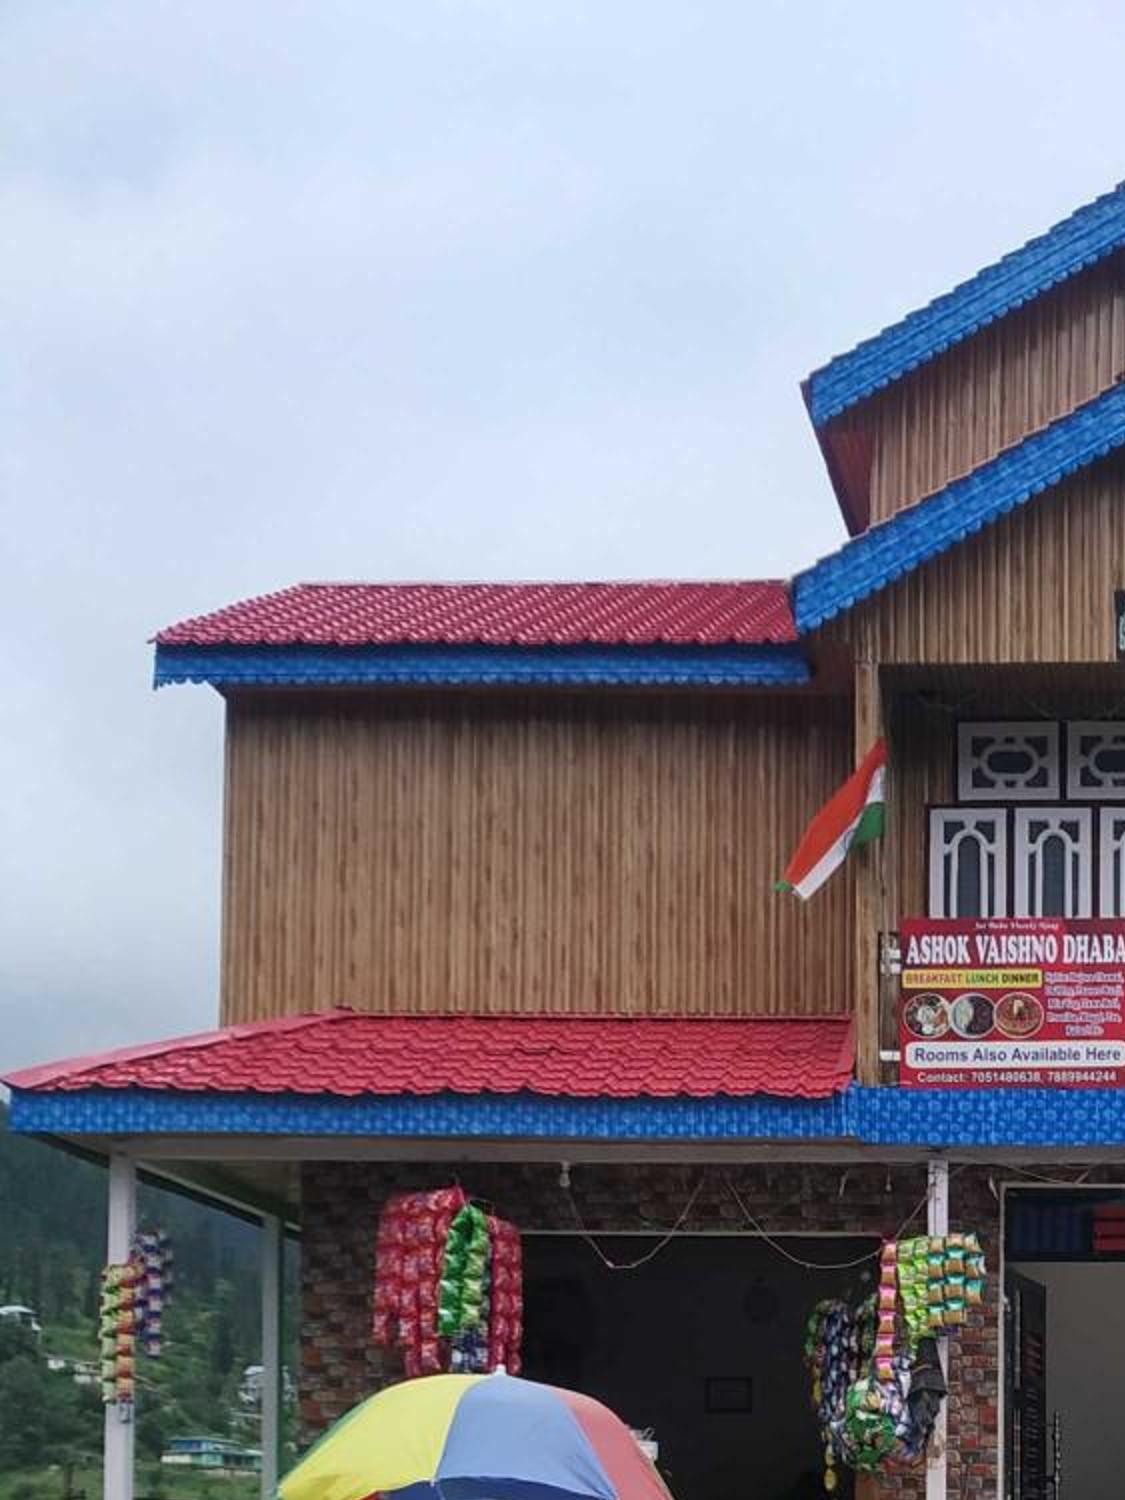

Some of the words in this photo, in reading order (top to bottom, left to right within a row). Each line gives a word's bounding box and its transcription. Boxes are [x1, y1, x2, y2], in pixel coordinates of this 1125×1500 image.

[905, 933, 972, 965] ASHOK
[975, 933, 1058, 965] VAISHNO
[905, 971, 962, 984] BREAKFAST
[965, 971, 999, 984] LUNCH
[1001, 971, 1039, 984] DINNER
[913, 1048, 969, 1062] Rooms
[972, 1048, 1007, 1062] Also
[1011, 1047, 1081, 1062] Available
[1085, 1048, 1122, 1061] Here
